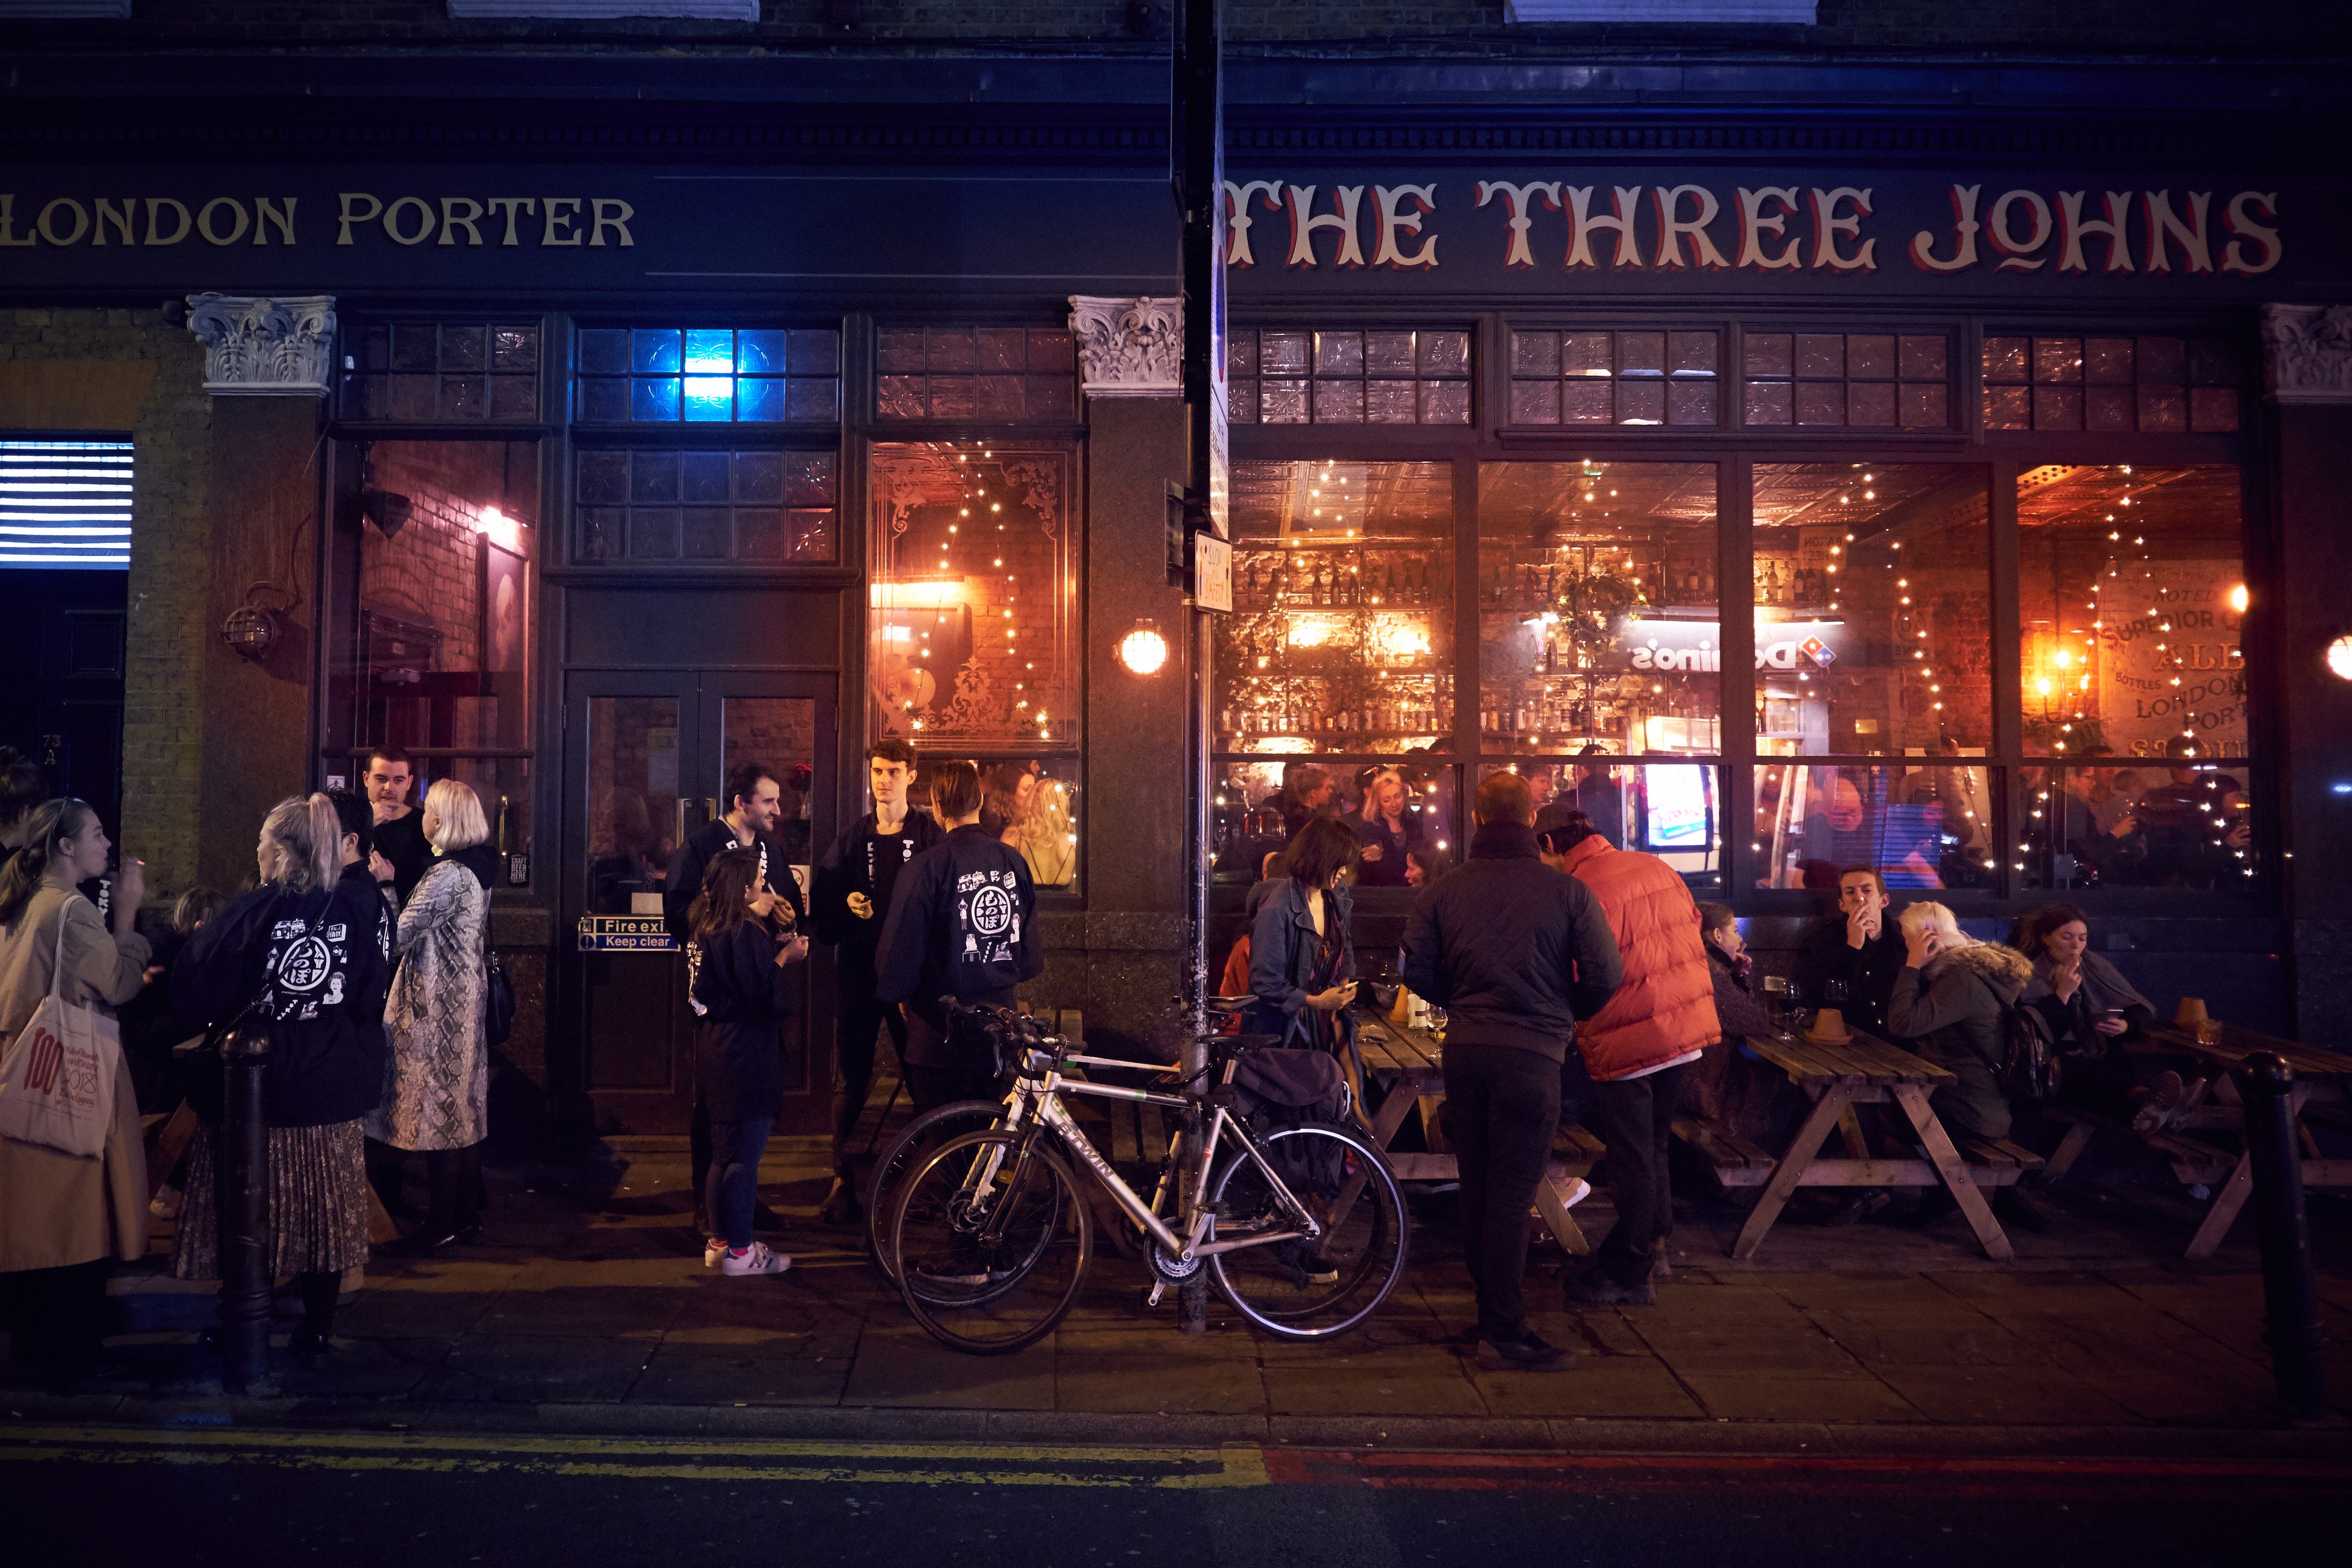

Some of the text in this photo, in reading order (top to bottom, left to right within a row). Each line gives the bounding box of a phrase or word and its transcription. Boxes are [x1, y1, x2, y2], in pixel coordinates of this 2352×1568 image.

[0, 192, 635, 246] LONDON PORTER
[1223, 180, 2283, 274] THE THREE JOHNS
[2116, 672, 2162, 690] BOTTLES
[42, 735, 62, 747] 73
[45, 750, 57, 765] A
[511, 864, 526, 872] BEER
[511, 871, 526, 880] HERE
[605, 920, 668, 932] Fire exi
[605, 936, 670, 949] Keep clear
[23, 1027, 64, 1095] 100
